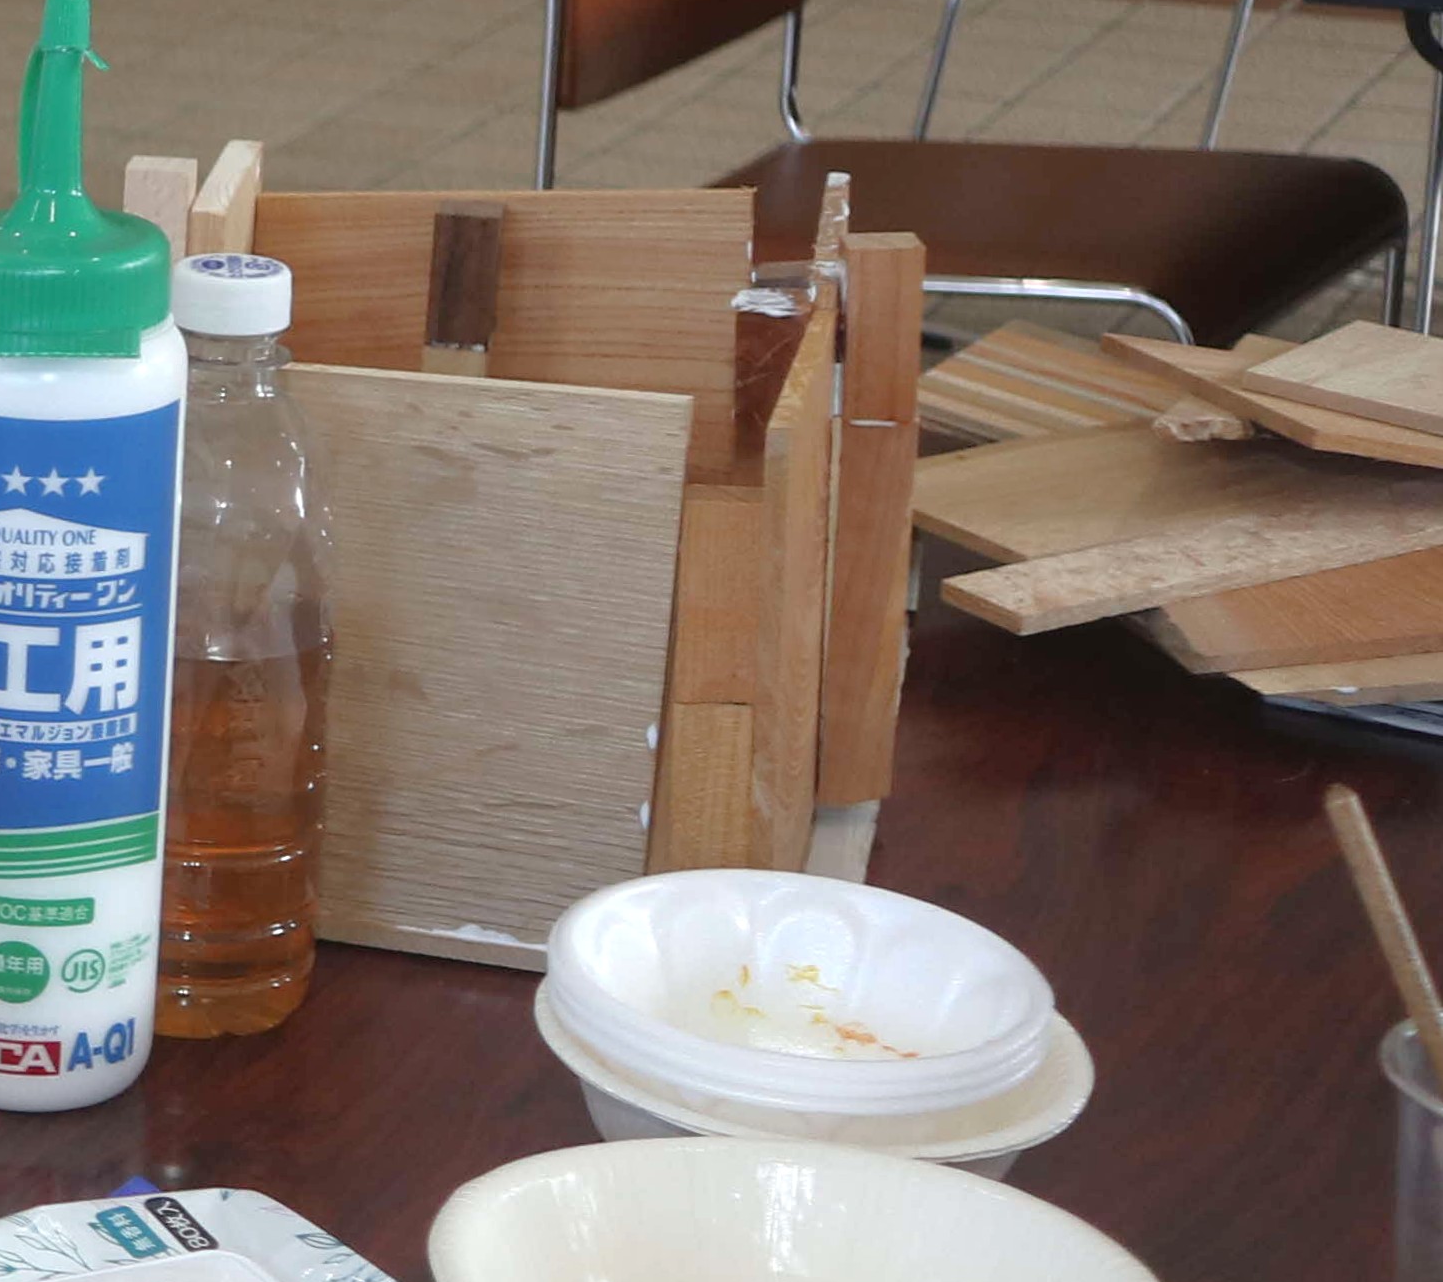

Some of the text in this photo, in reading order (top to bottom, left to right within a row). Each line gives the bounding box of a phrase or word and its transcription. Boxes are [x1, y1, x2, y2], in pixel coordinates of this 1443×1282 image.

[62, 528, 96, 547] ONE
[96, 578, 137, 608] ワン
[67, 1018, 135, 1072] A-Q1
